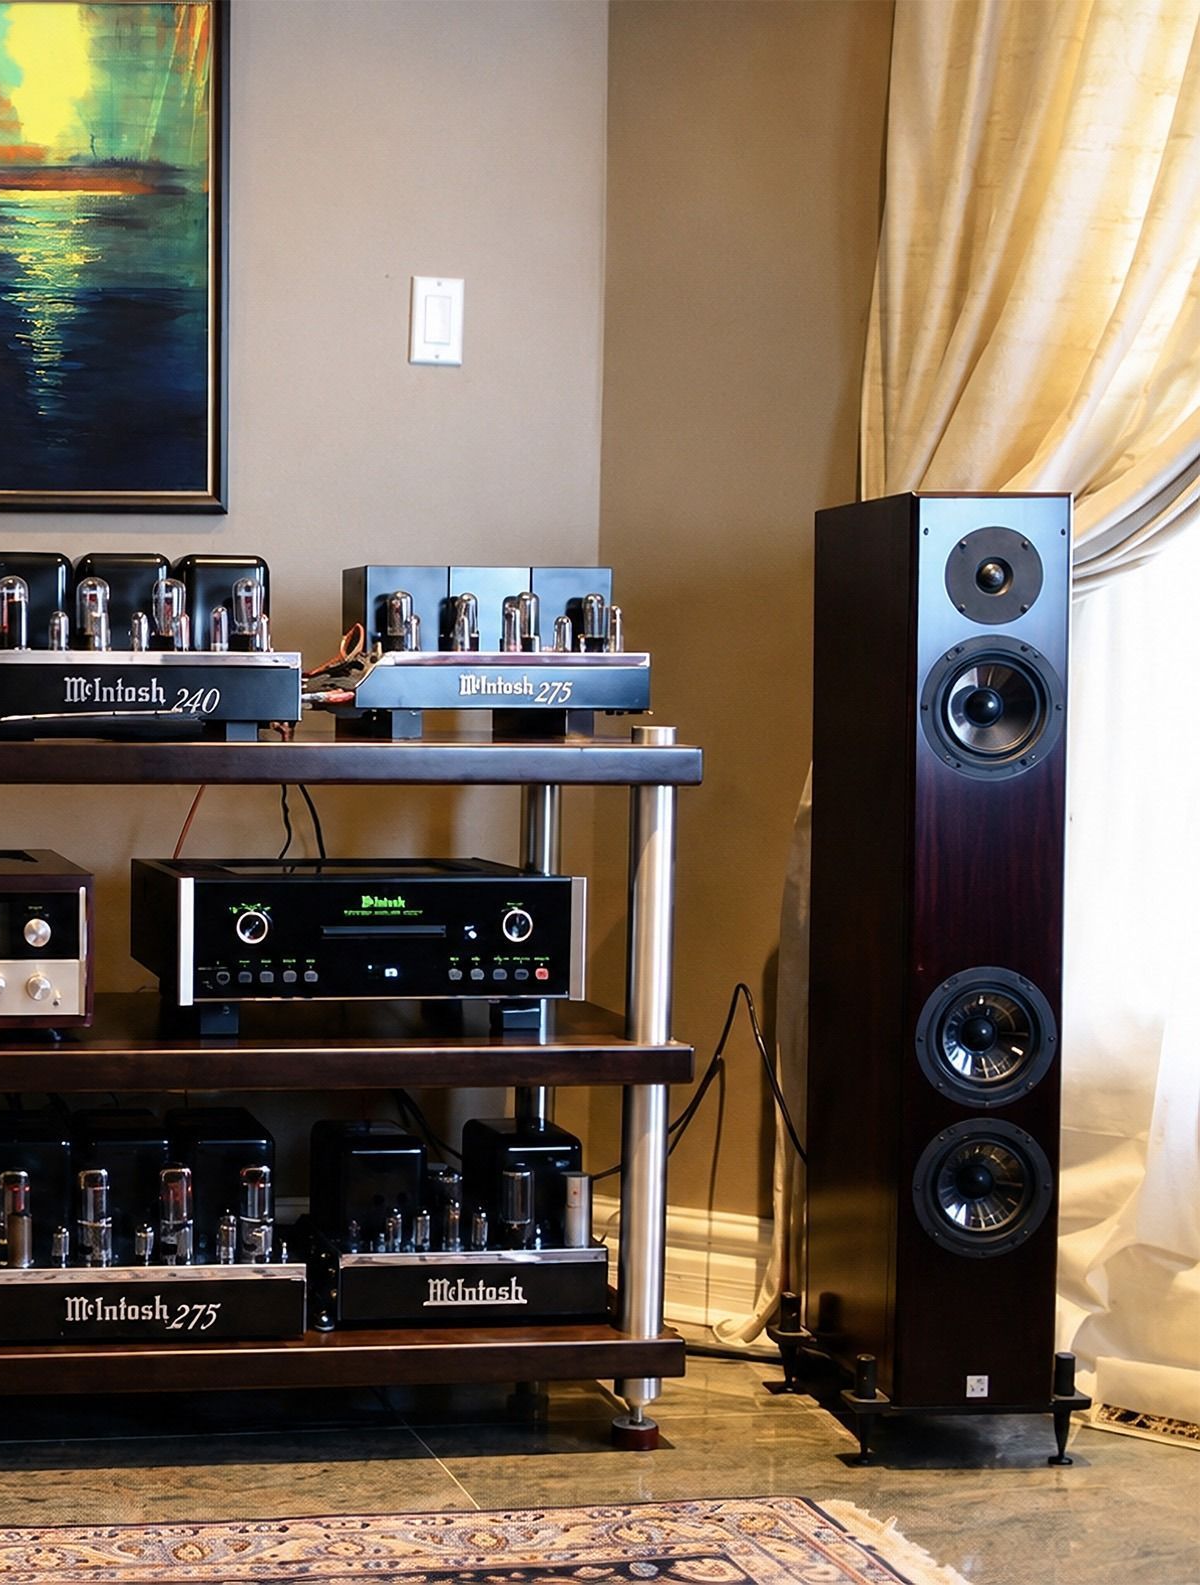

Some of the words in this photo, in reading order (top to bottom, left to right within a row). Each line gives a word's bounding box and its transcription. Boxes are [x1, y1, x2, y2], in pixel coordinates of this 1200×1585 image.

[63, 676, 167, 706] McIntosh
[171, 688, 221, 714] 240
[459, 673, 534, 695] McIntosh
[534, 681, 573, 705] 275
[423, 1275, 528, 1306] McIntosh
[64, 1295, 170, 1324] McIntosh
[165, 1302, 221, 1330] 275
